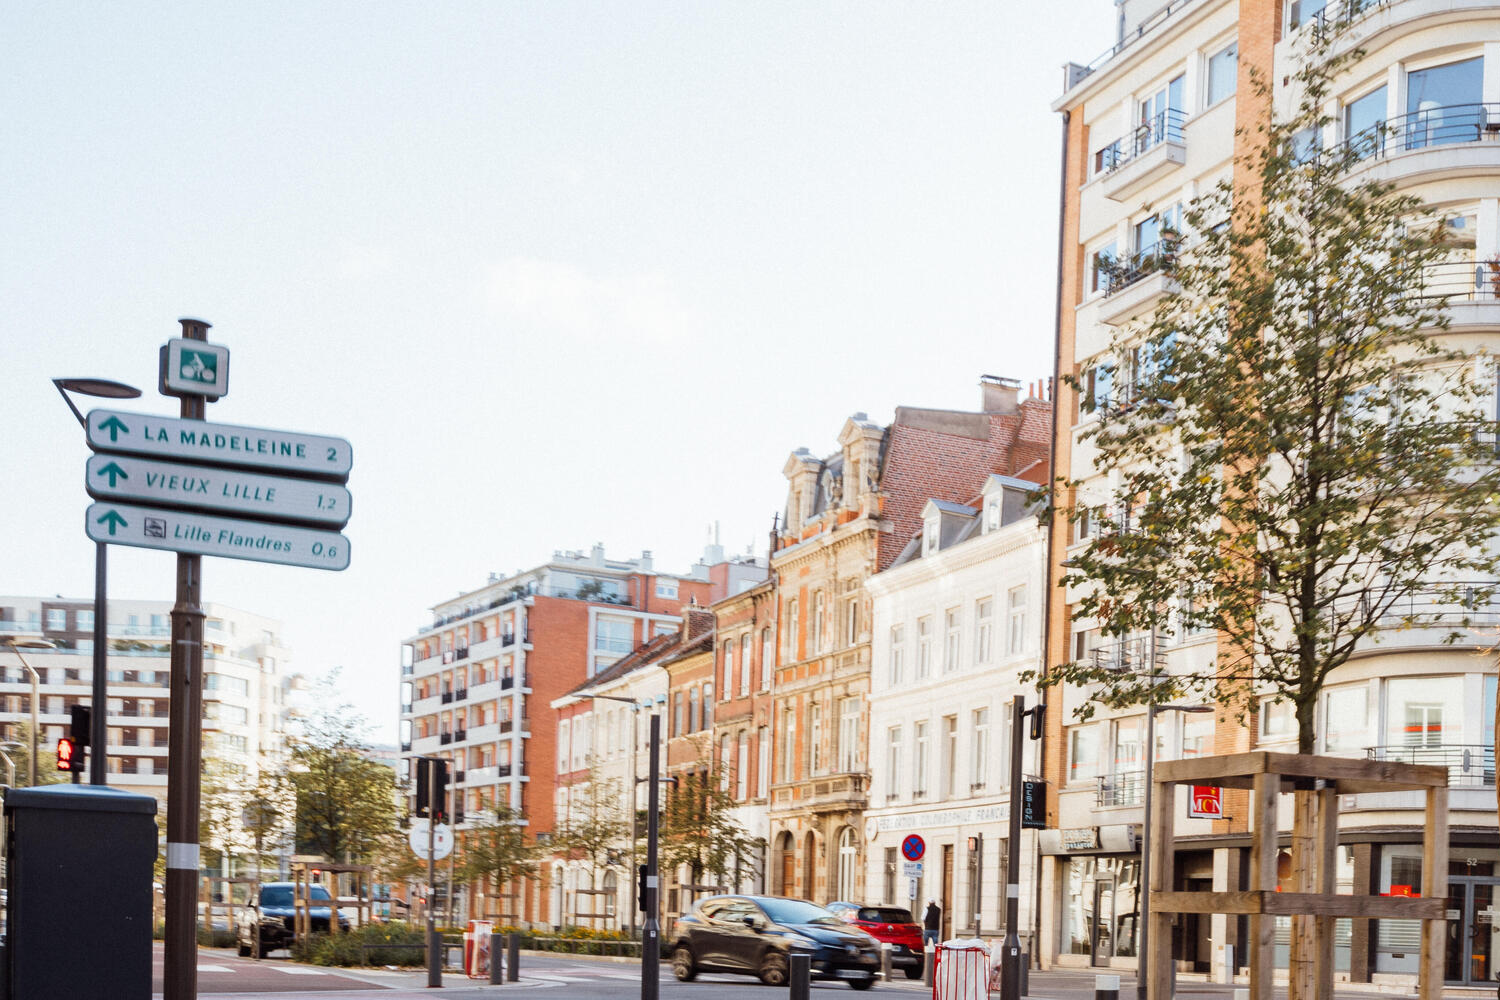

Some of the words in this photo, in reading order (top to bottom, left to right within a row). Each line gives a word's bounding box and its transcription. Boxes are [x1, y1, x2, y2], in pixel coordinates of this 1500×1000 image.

[145, 426, 168, 442] LA
[180, 430, 306, 458] MADELEINE
[327, 447, 337, 461] 2
[146, 473, 211, 494] VIEUX
[222, 482, 276, 502] LILLE
[317, 494, 336, 511] 1,2
[174, 524, 211, 542] Lille
[218, 529, 292, 552] Flandres
[312, 542, 337, 558] 0,6
[1024, 782, 1034, 820] DESIGN
[1466, 858, 1478, 866] 52
